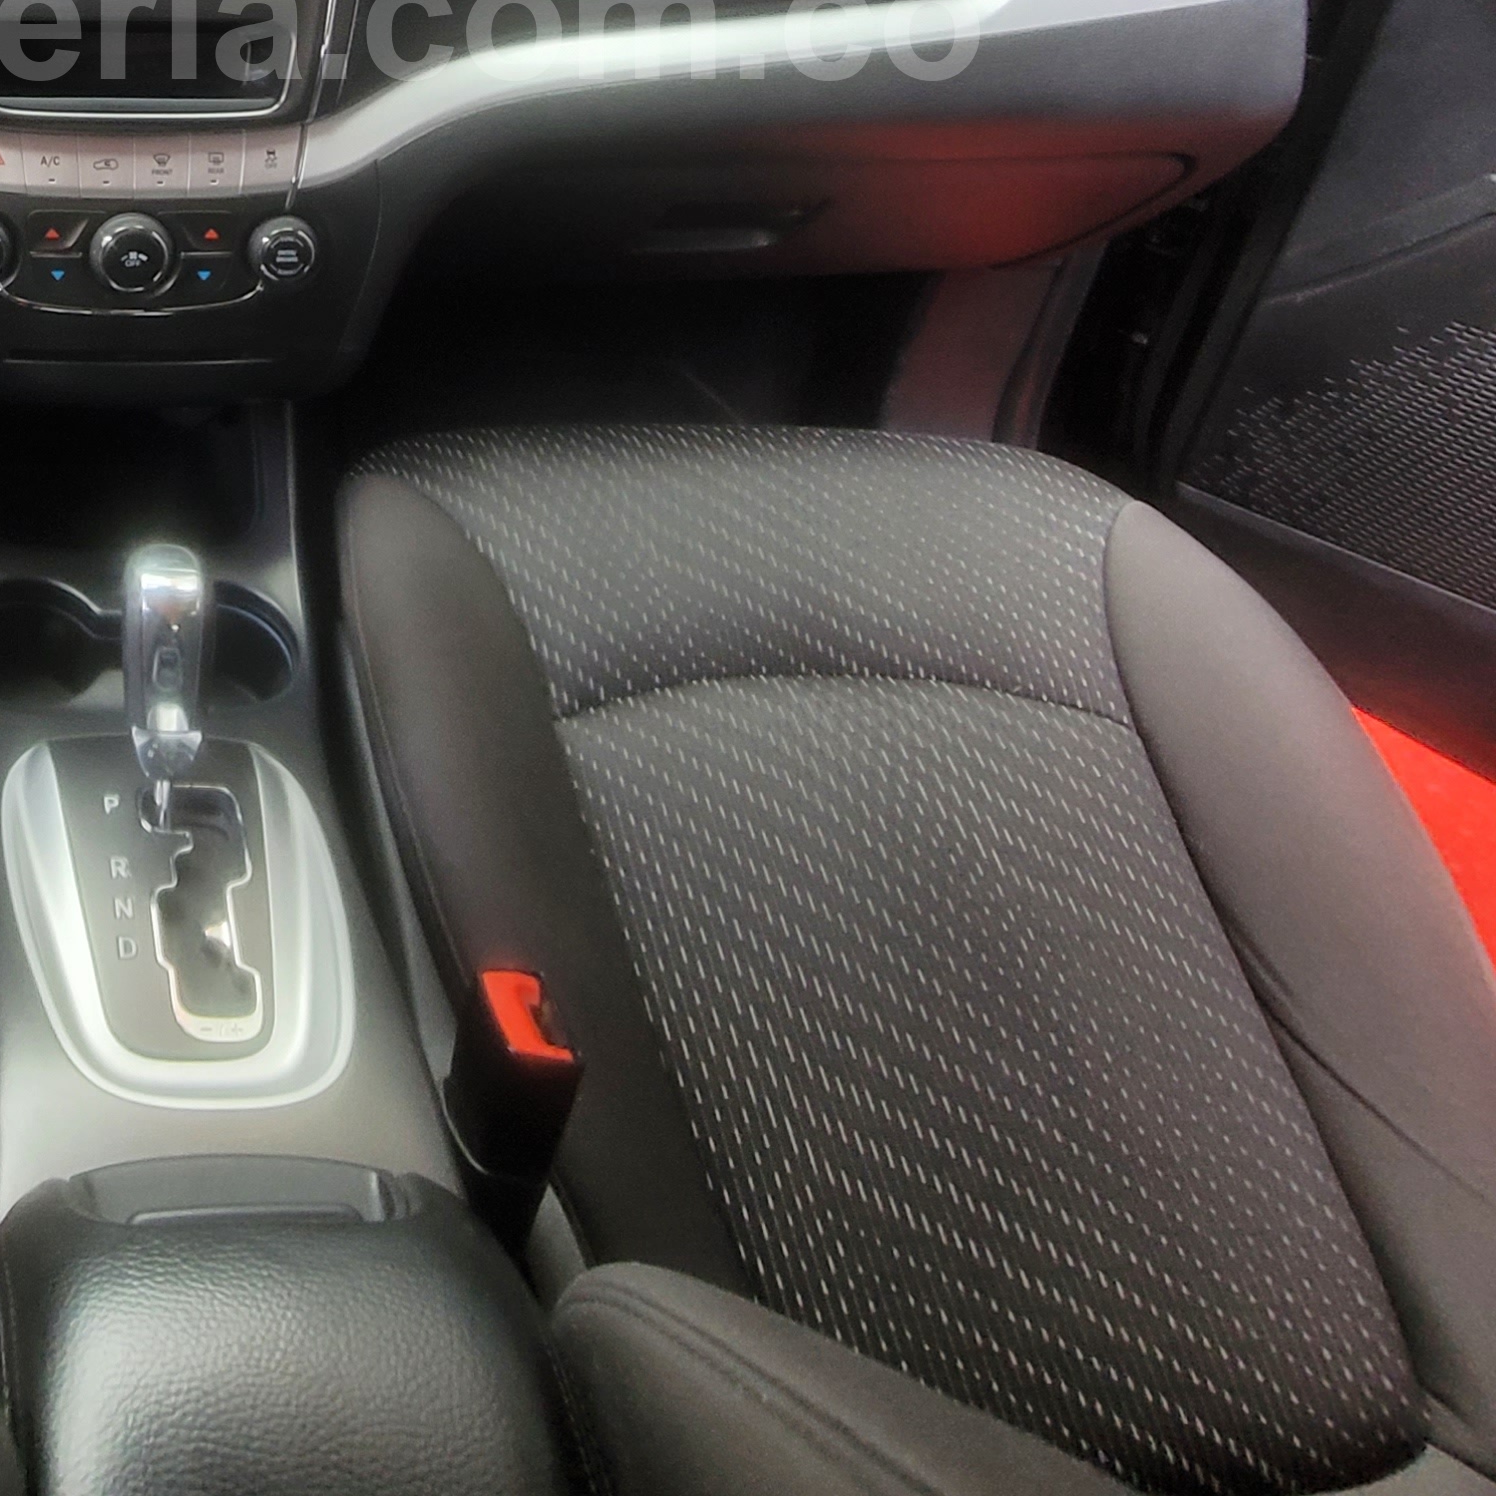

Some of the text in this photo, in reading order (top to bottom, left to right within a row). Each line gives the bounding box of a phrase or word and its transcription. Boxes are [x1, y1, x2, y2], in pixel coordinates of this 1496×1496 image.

[40, 156, 61, 166] A/C
[152, 168, 173, 176] FRONT
[208, 167, 225, 175] REAR
[124, 259, 141, 268] OFF
[104, 795, 120, 814] P
[110, 857, 131, 879] R
[115, 898, 134, 919] N
[118, 936, 138, 959] D
